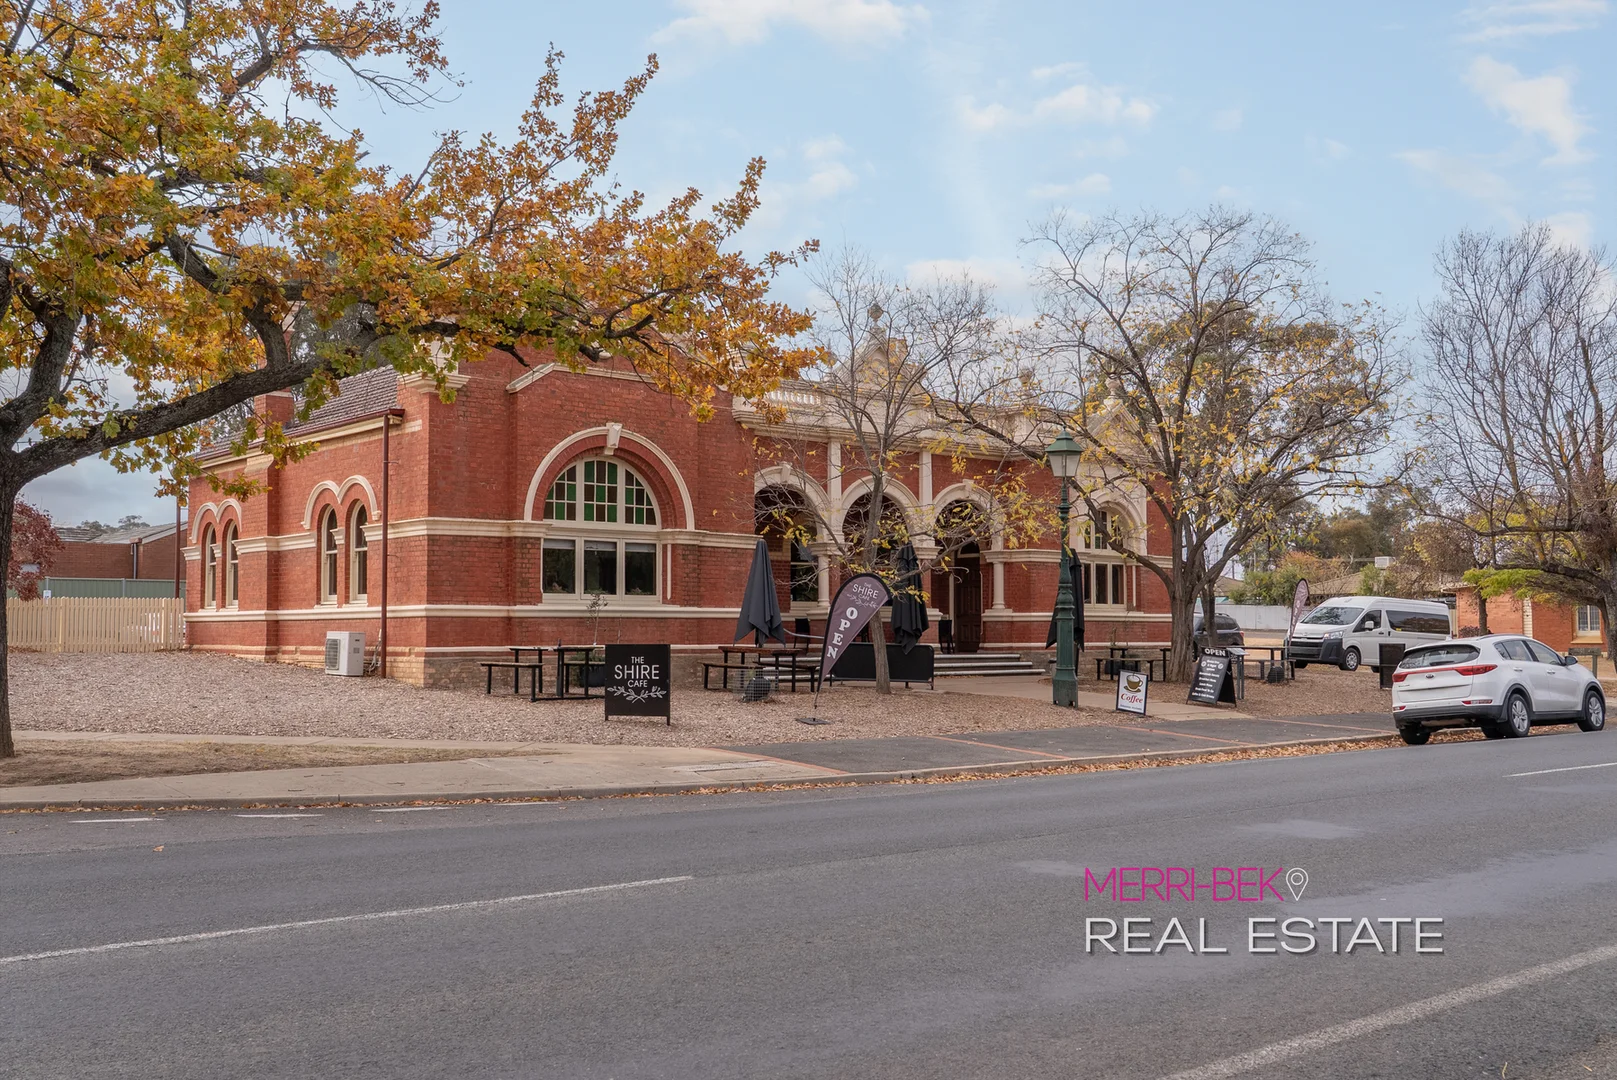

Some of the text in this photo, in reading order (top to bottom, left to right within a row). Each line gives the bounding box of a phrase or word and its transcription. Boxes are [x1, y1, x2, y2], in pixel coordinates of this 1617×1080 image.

[852, 583, 879, 599] SHIRE
[827, 606, 858, 659] OPEN
[1204, 648, 1226, 656] OPEN
[631, 656, 645, 664] THE
[614, 664, 660, 680] SHIRE
[627, 679, 648, 688] CAFE
[1120, 693, 1143, 704] Coffee
